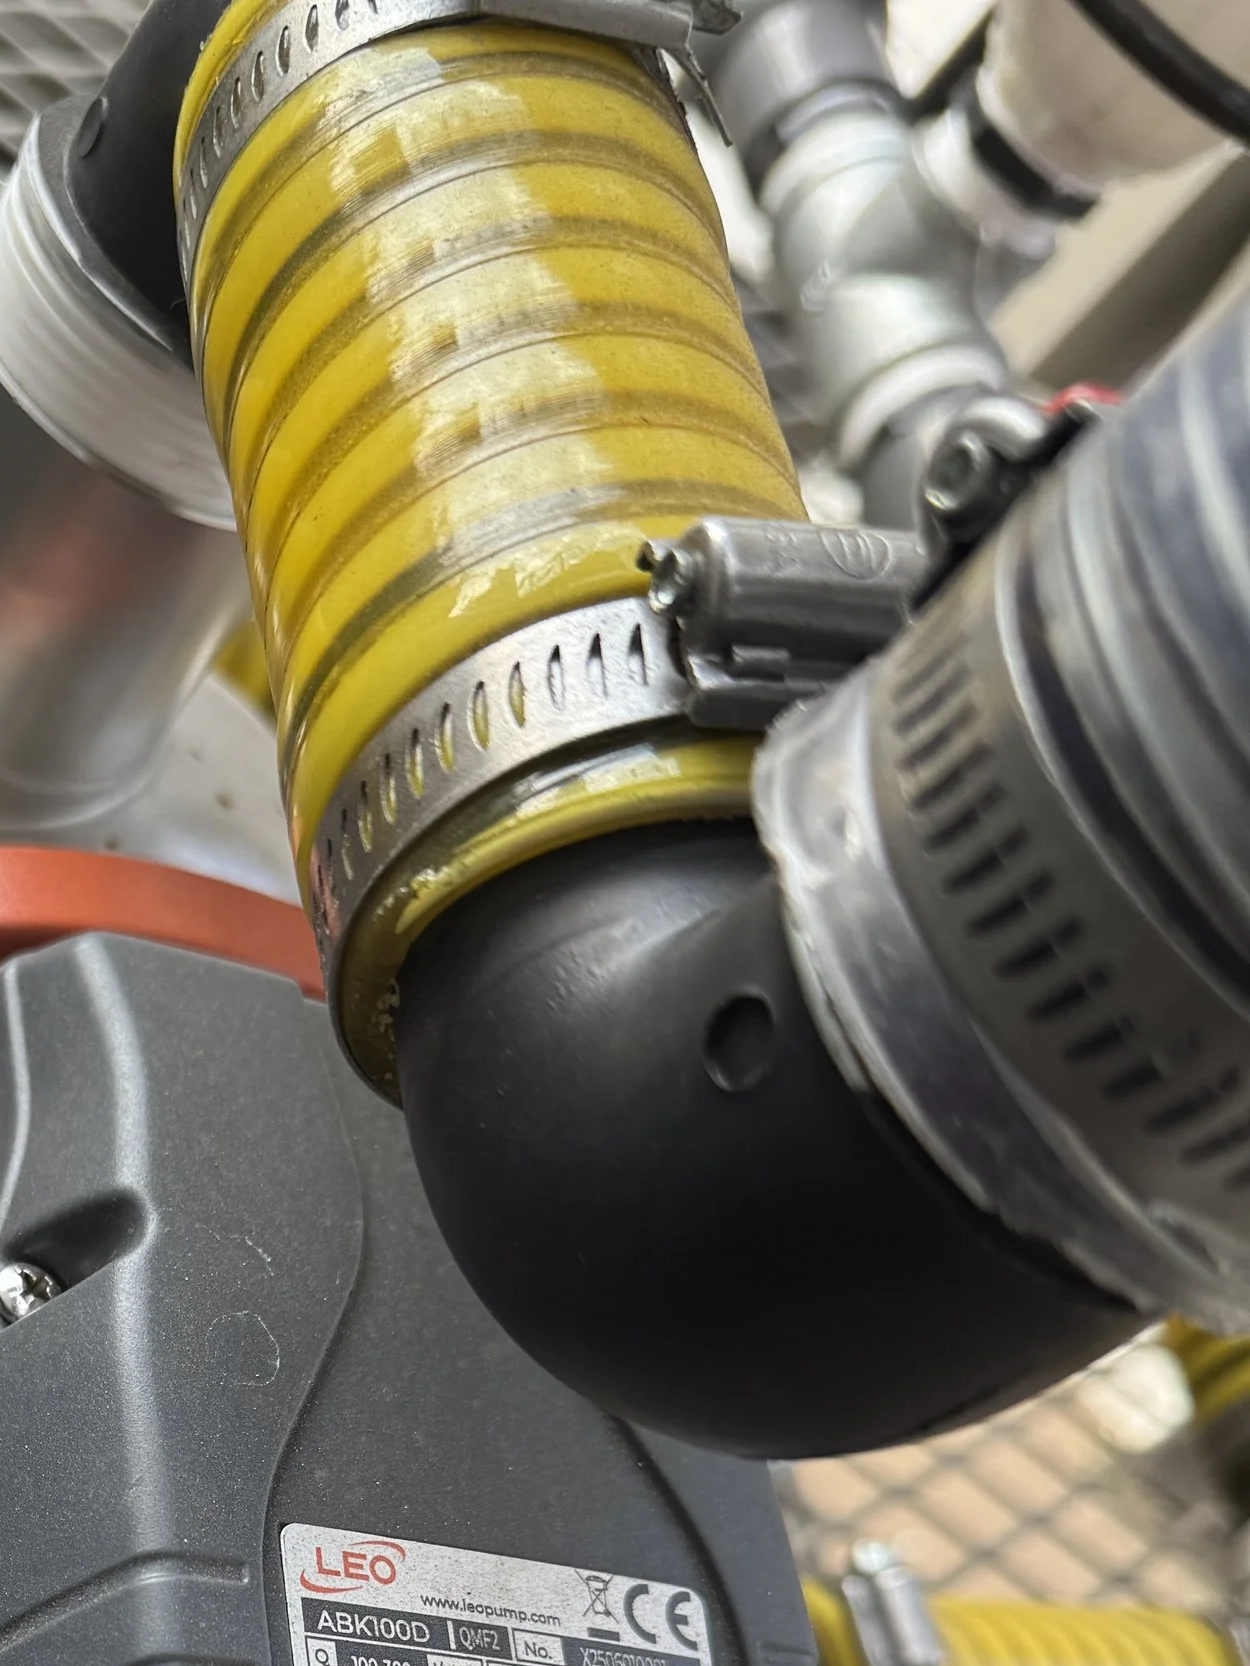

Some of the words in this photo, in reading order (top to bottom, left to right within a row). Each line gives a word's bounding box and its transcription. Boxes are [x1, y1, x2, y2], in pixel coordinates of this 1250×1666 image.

[315, 1546, 396, 1585] LEO
[420, 1594, 561, 1627] www.leopump.com
[317, 1610, 430, 1643] ABK100D
[524, 1641, 552, 1660] No.
[314, 1648, 330, 1666] Q
